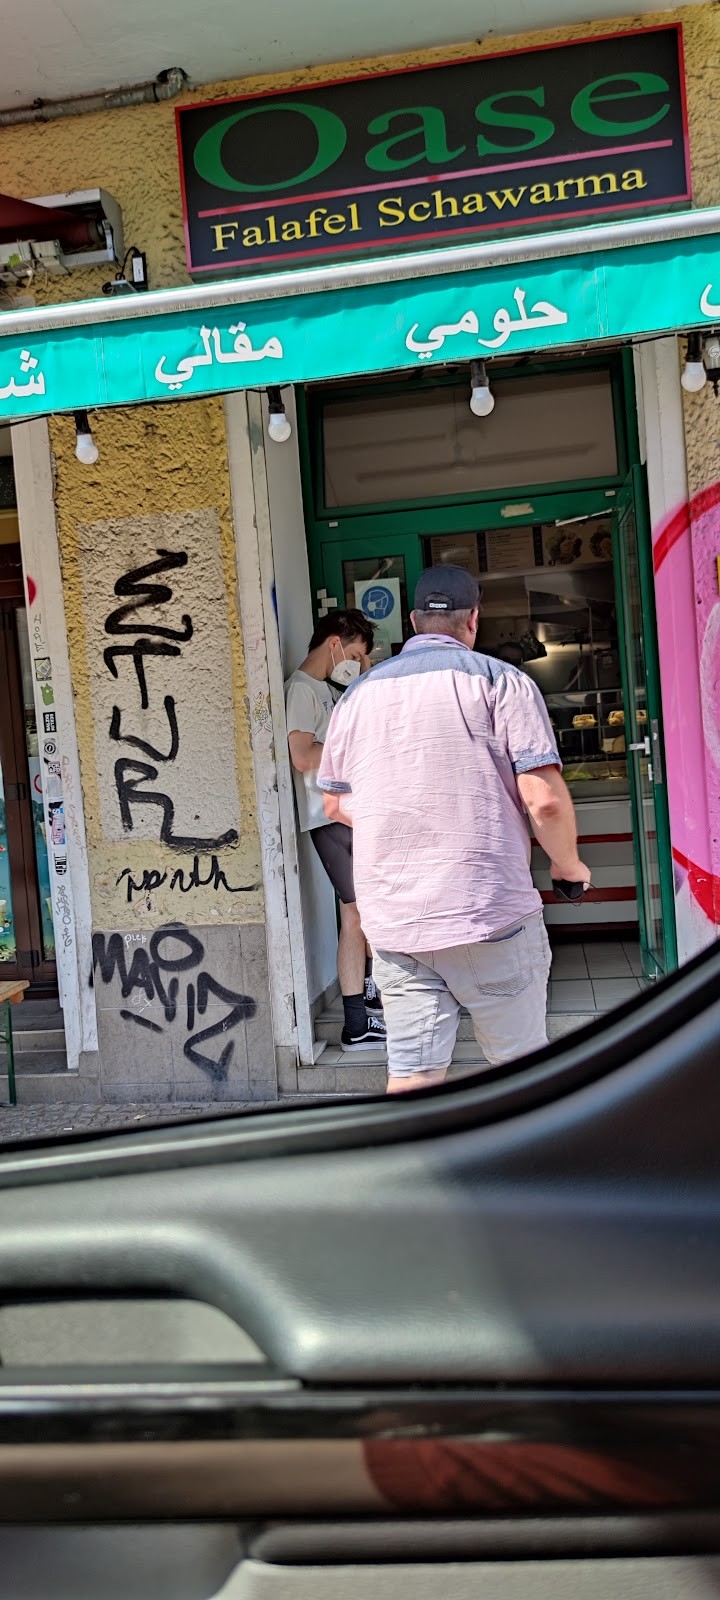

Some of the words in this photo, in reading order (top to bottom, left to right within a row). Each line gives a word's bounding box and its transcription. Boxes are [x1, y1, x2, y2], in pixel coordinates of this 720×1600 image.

[193, 72, 671, 193] Oase
[210, 203, 360, 252] Falafel
[377, 168, 649, 228] Schawarma
[154, 321, 284, 391] مقالي
[404, 286, 569, 360] حلومي
